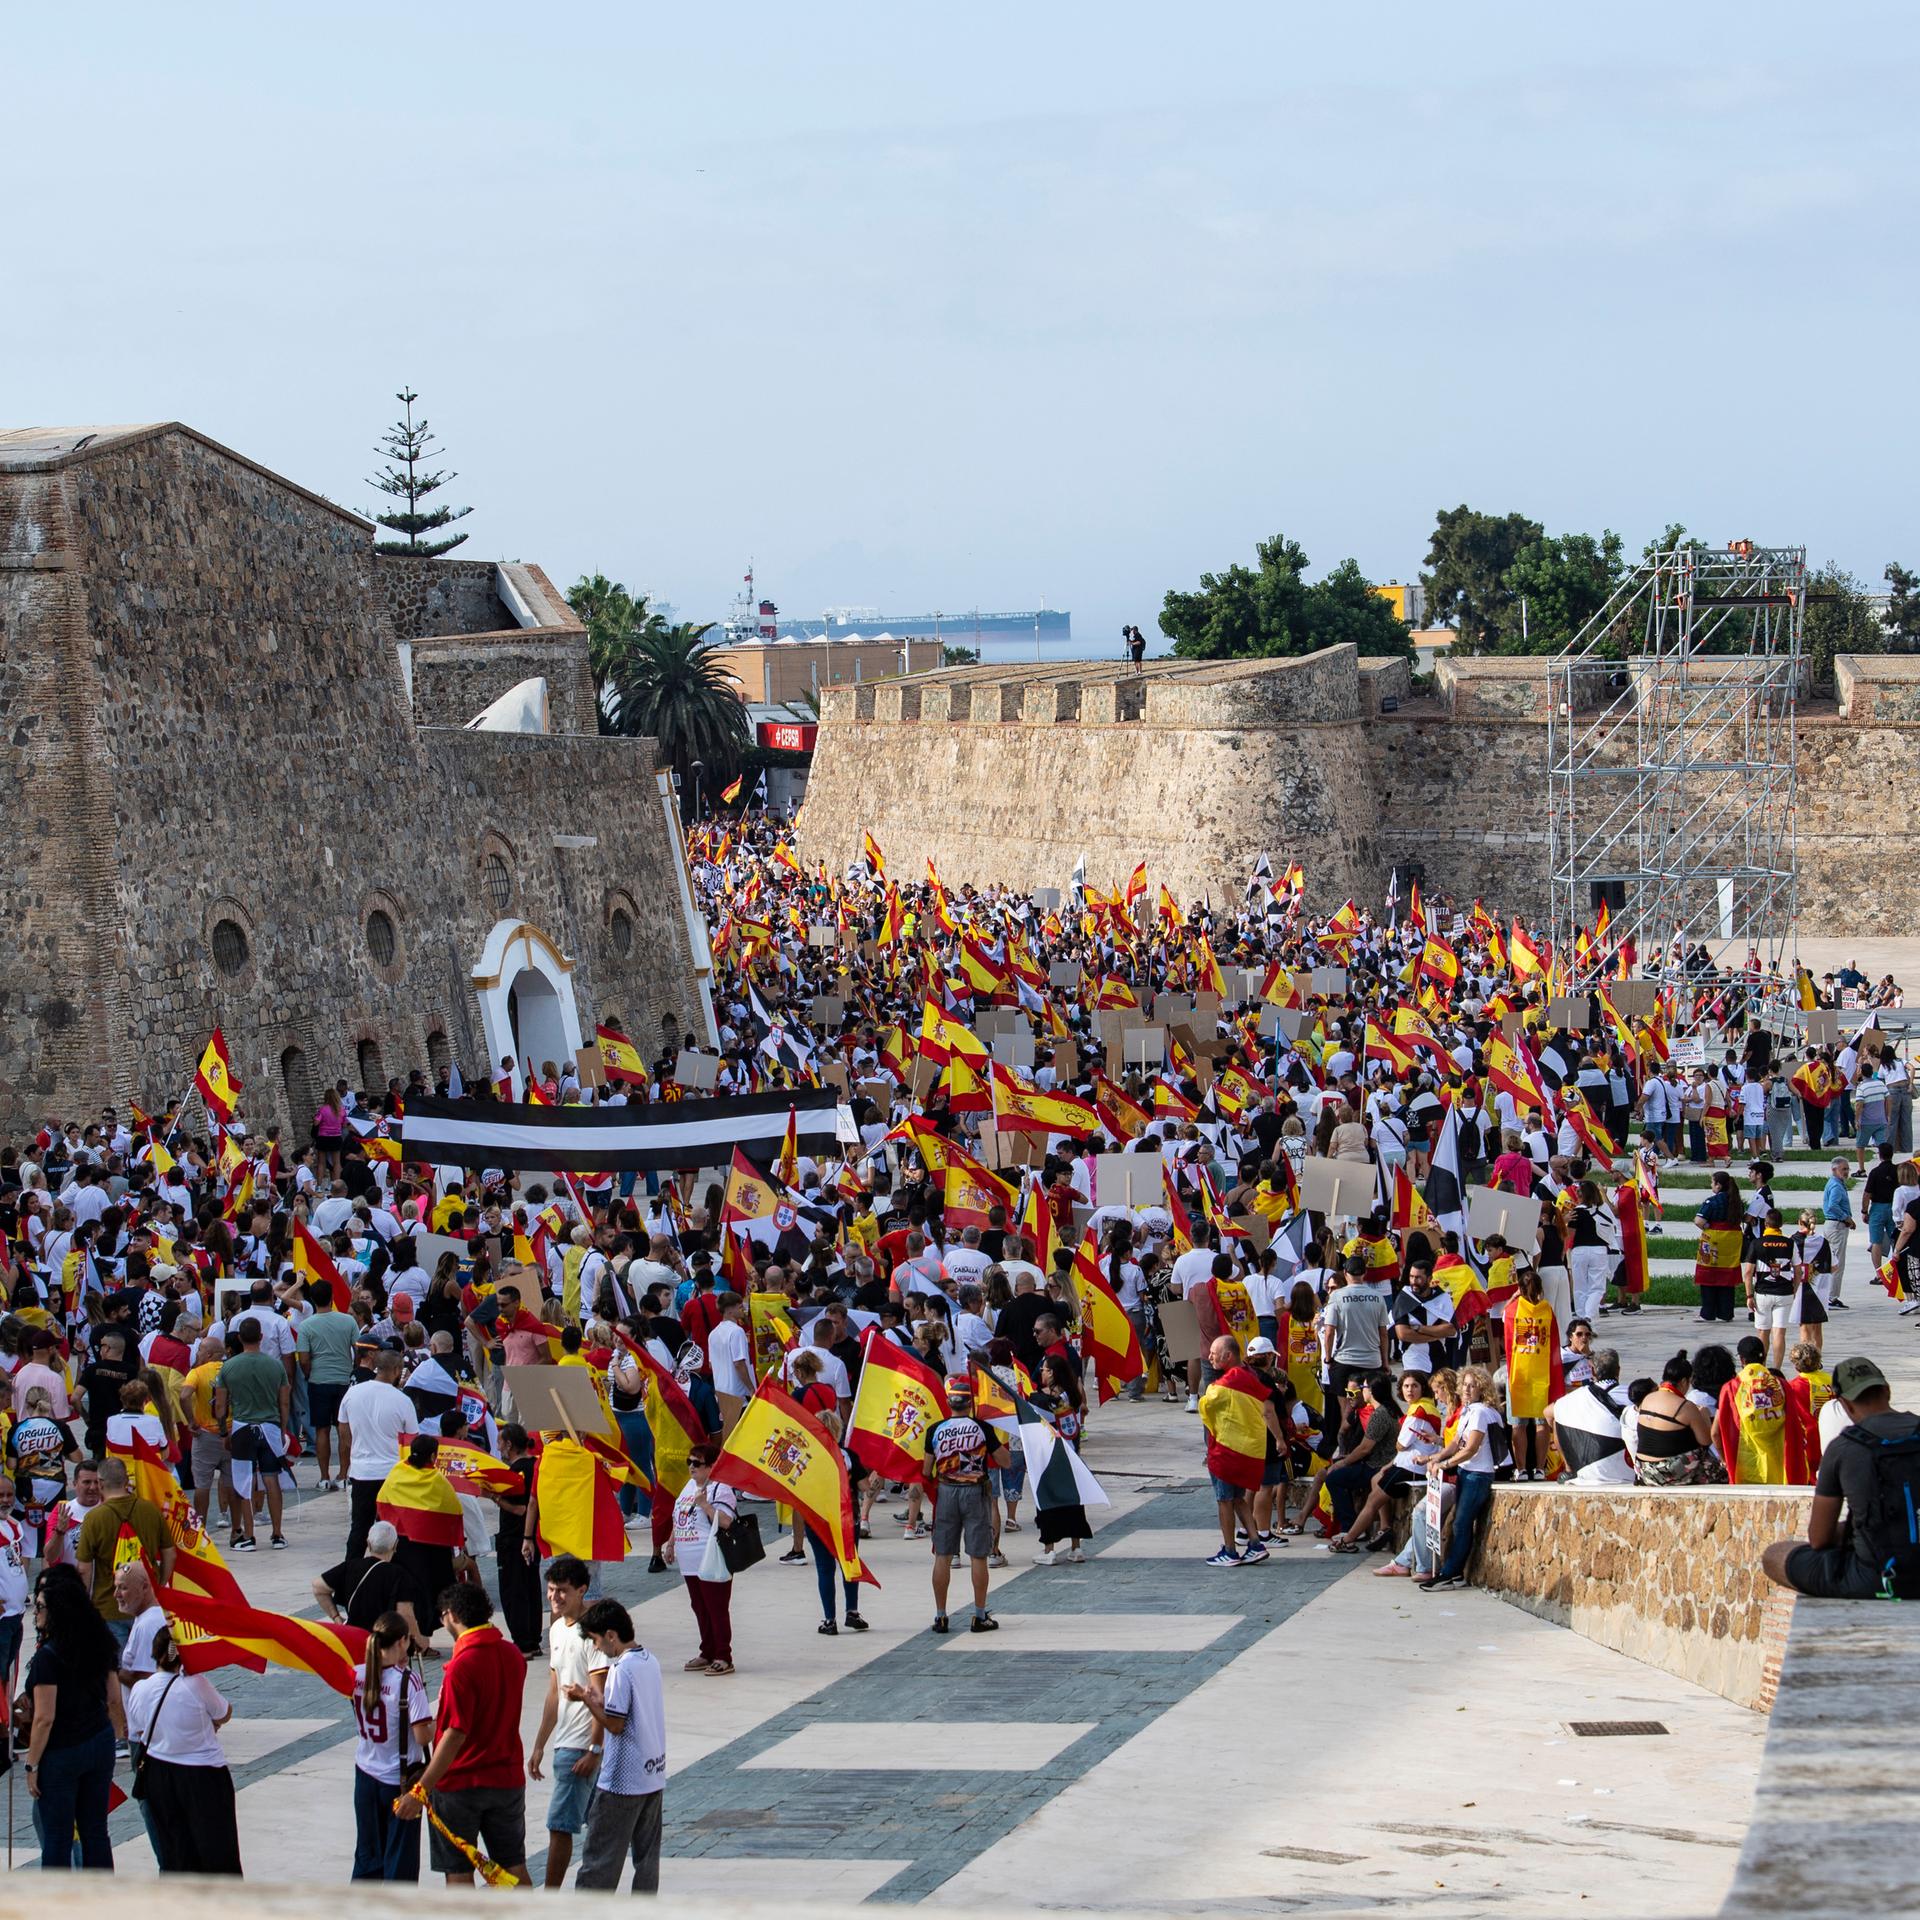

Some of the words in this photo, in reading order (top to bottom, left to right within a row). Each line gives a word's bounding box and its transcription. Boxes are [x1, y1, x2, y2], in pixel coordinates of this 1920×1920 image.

[781, 728, 799, 747] CEPSA
[1342, 1294, 1380, 1303] macron
[17, 1427, 58, 1441] ORGULLO
[937, 1425, 979, 1441] ORGULLO
[354, 1694, 389, 1744] 19
